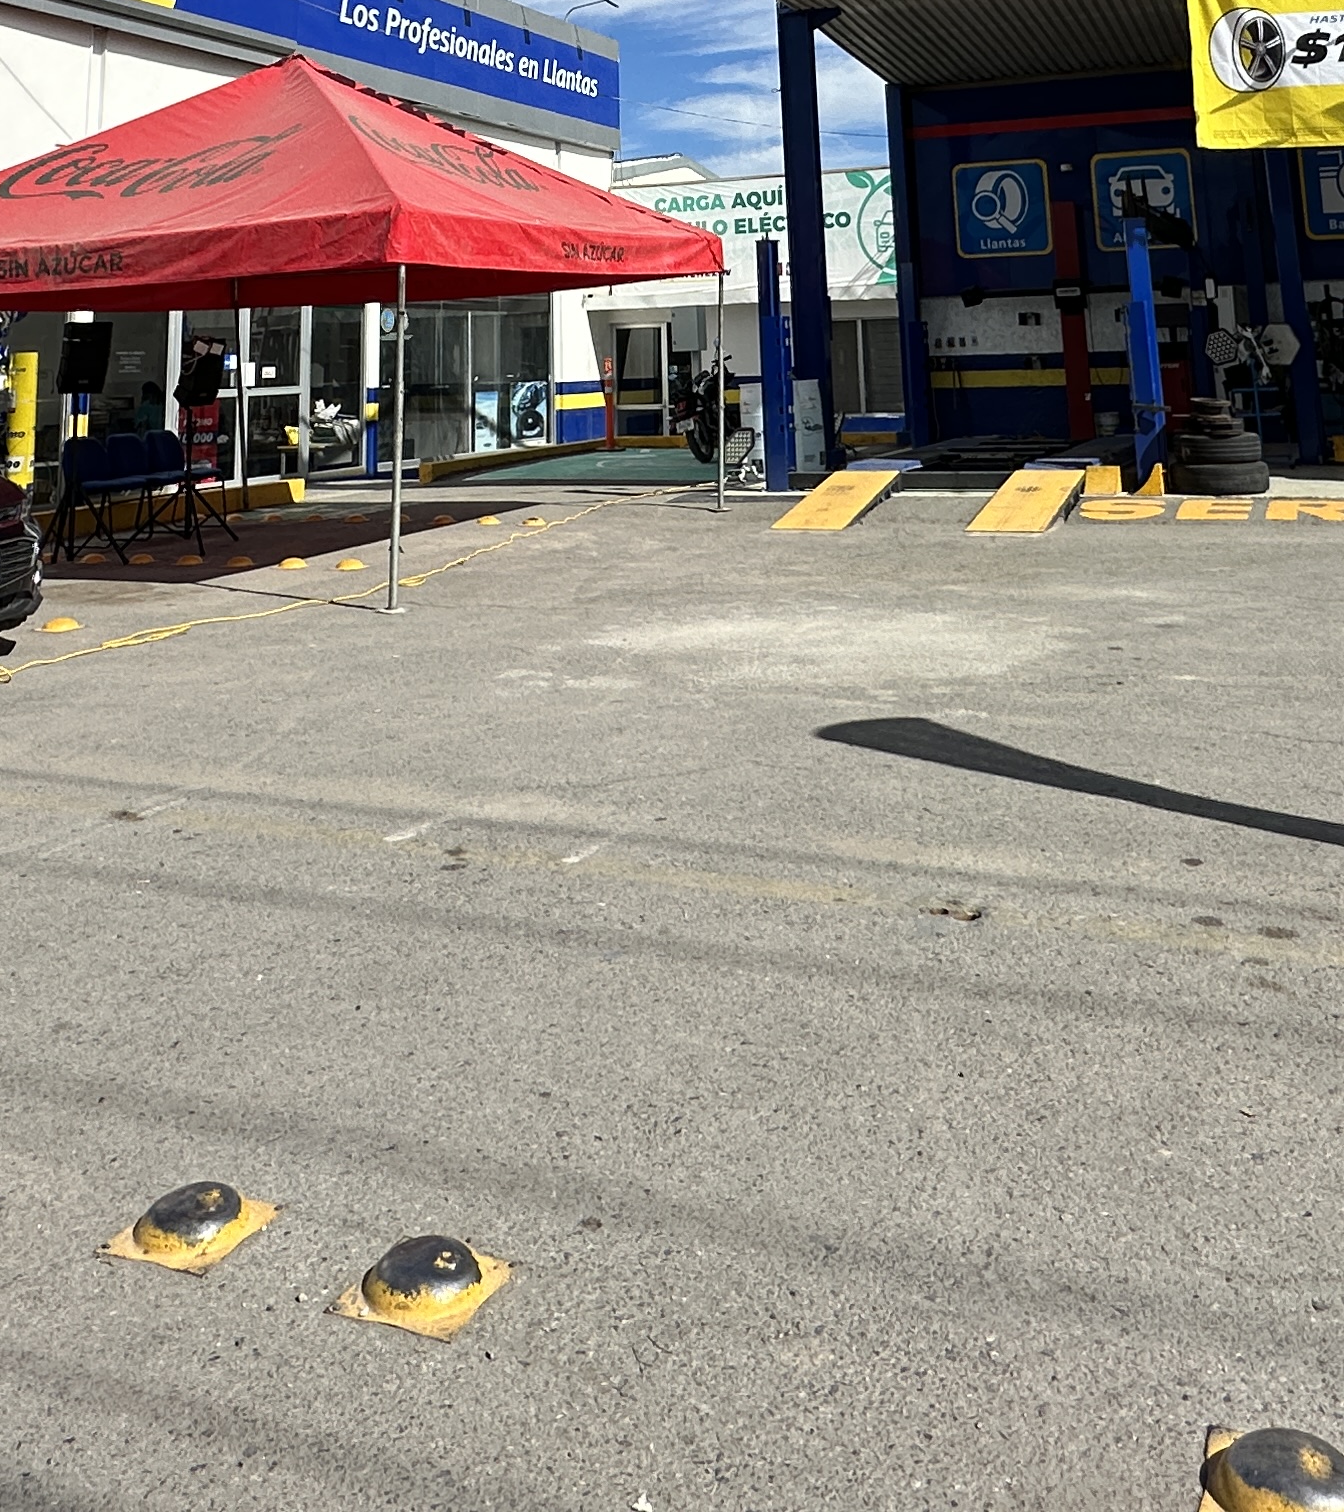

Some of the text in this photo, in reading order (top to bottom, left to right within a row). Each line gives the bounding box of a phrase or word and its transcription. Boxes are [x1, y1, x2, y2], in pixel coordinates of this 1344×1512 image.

[386, 0, 514, 74] Profesionales
[518, 55, 539, 80] en
[543, 49, 598, 98] Llantas
[654, 185, 783, 213] CARGA AQUÍ
[980, 238, 1027, 250] Llantas
[36, 251, 123, 277] AZÚCAR
